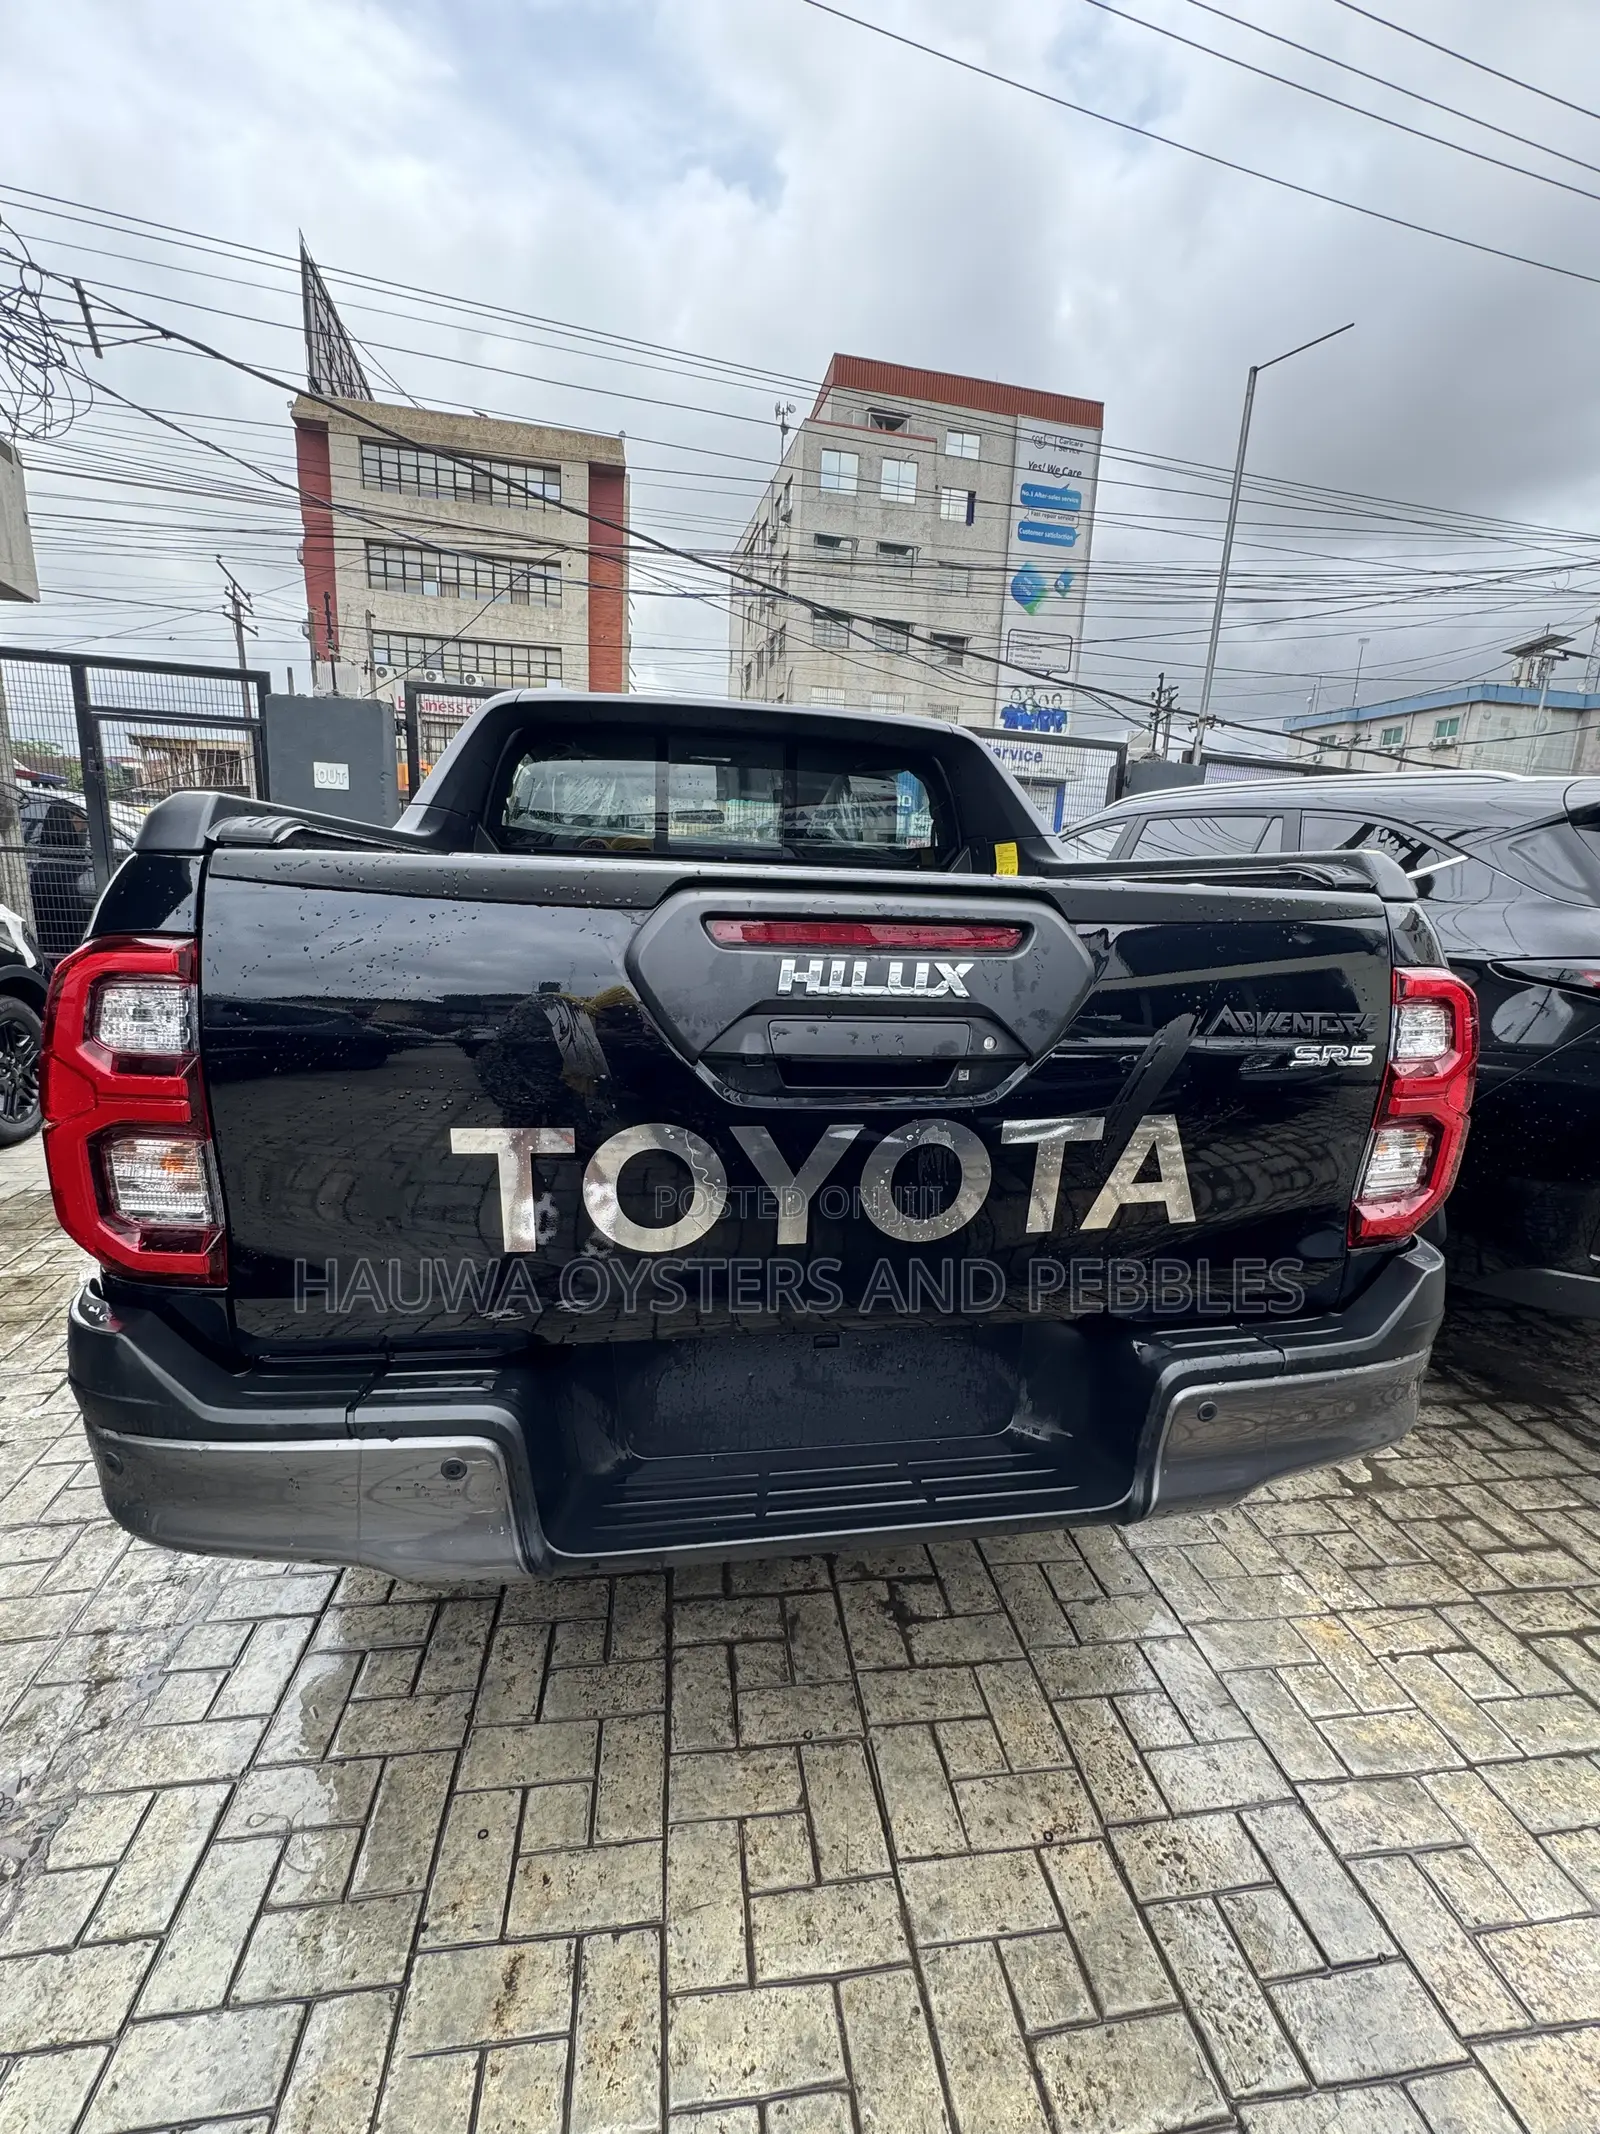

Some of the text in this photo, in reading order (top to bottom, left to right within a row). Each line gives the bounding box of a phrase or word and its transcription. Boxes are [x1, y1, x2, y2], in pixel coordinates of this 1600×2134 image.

[1028, 460, 1082, 477] Yes! We Care
[1019, 527, 1073, 540] Customer satisfaction
[986, 742, 1043, 764] ervice
[316, 768, 347, 786] OUT
[776, 958, 975, 998] HILUX
[1204, 1003, 1380, 1037] ADVENTURE
[1289, 1045, 1376, 1067] SR5
[449, 1113, 1197, 1252] TOYOTA
